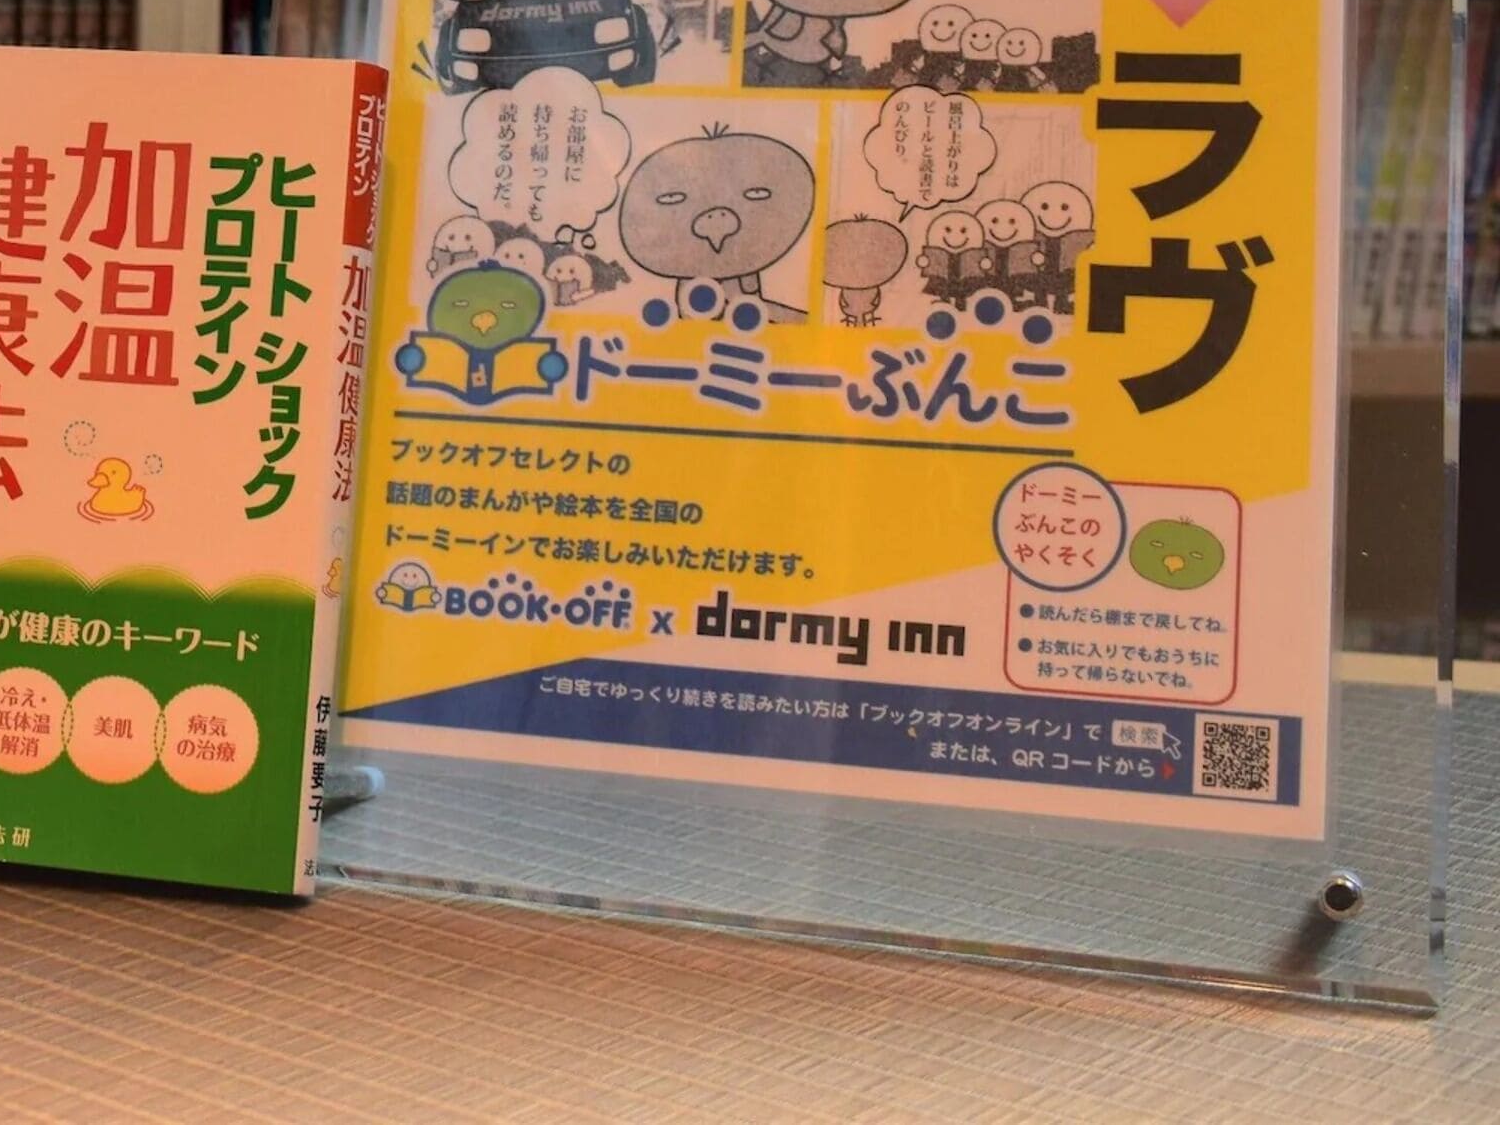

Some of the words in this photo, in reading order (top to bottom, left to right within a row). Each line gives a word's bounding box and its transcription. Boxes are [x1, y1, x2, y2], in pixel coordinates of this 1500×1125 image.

[353, 94, 375, 196] プロテイン
[566, 106, 587, 182] お部屋に
[49, 122, 192, 387] 加温
[192, 152, 263, 405] プロテイン
[242, 156, 316, 520] ヒートショック
[575, 336, 1070, 425] ドーミーぶんこ
[390, 438, 631, 475] ブックオフセレクトの
[386, 481, 704, 525] 話題のまんがや絵本を全国の
[1019, 483, 1102, 506] ドーミー
[1014, 515, 1101, 538] ぶんこの
[384, 524, 816, 579] ドーミーインでお楽しみいただけます。
[1013, 543, 1096, 569] やくそく
[696, 590, 871, 667] dormy
[888, 620, 966, 657] inn
[1037, 638, 1220, 667] お気に入りでもおうちに
[1037, 661, 1192, 689] 持って帰らないでね。
[93, 716, 133, 740] 美肌
[187, 714, 228, 739] 病気
[0, 735, 40, 759] 解消
[176, 739, 237, 763] の治療
